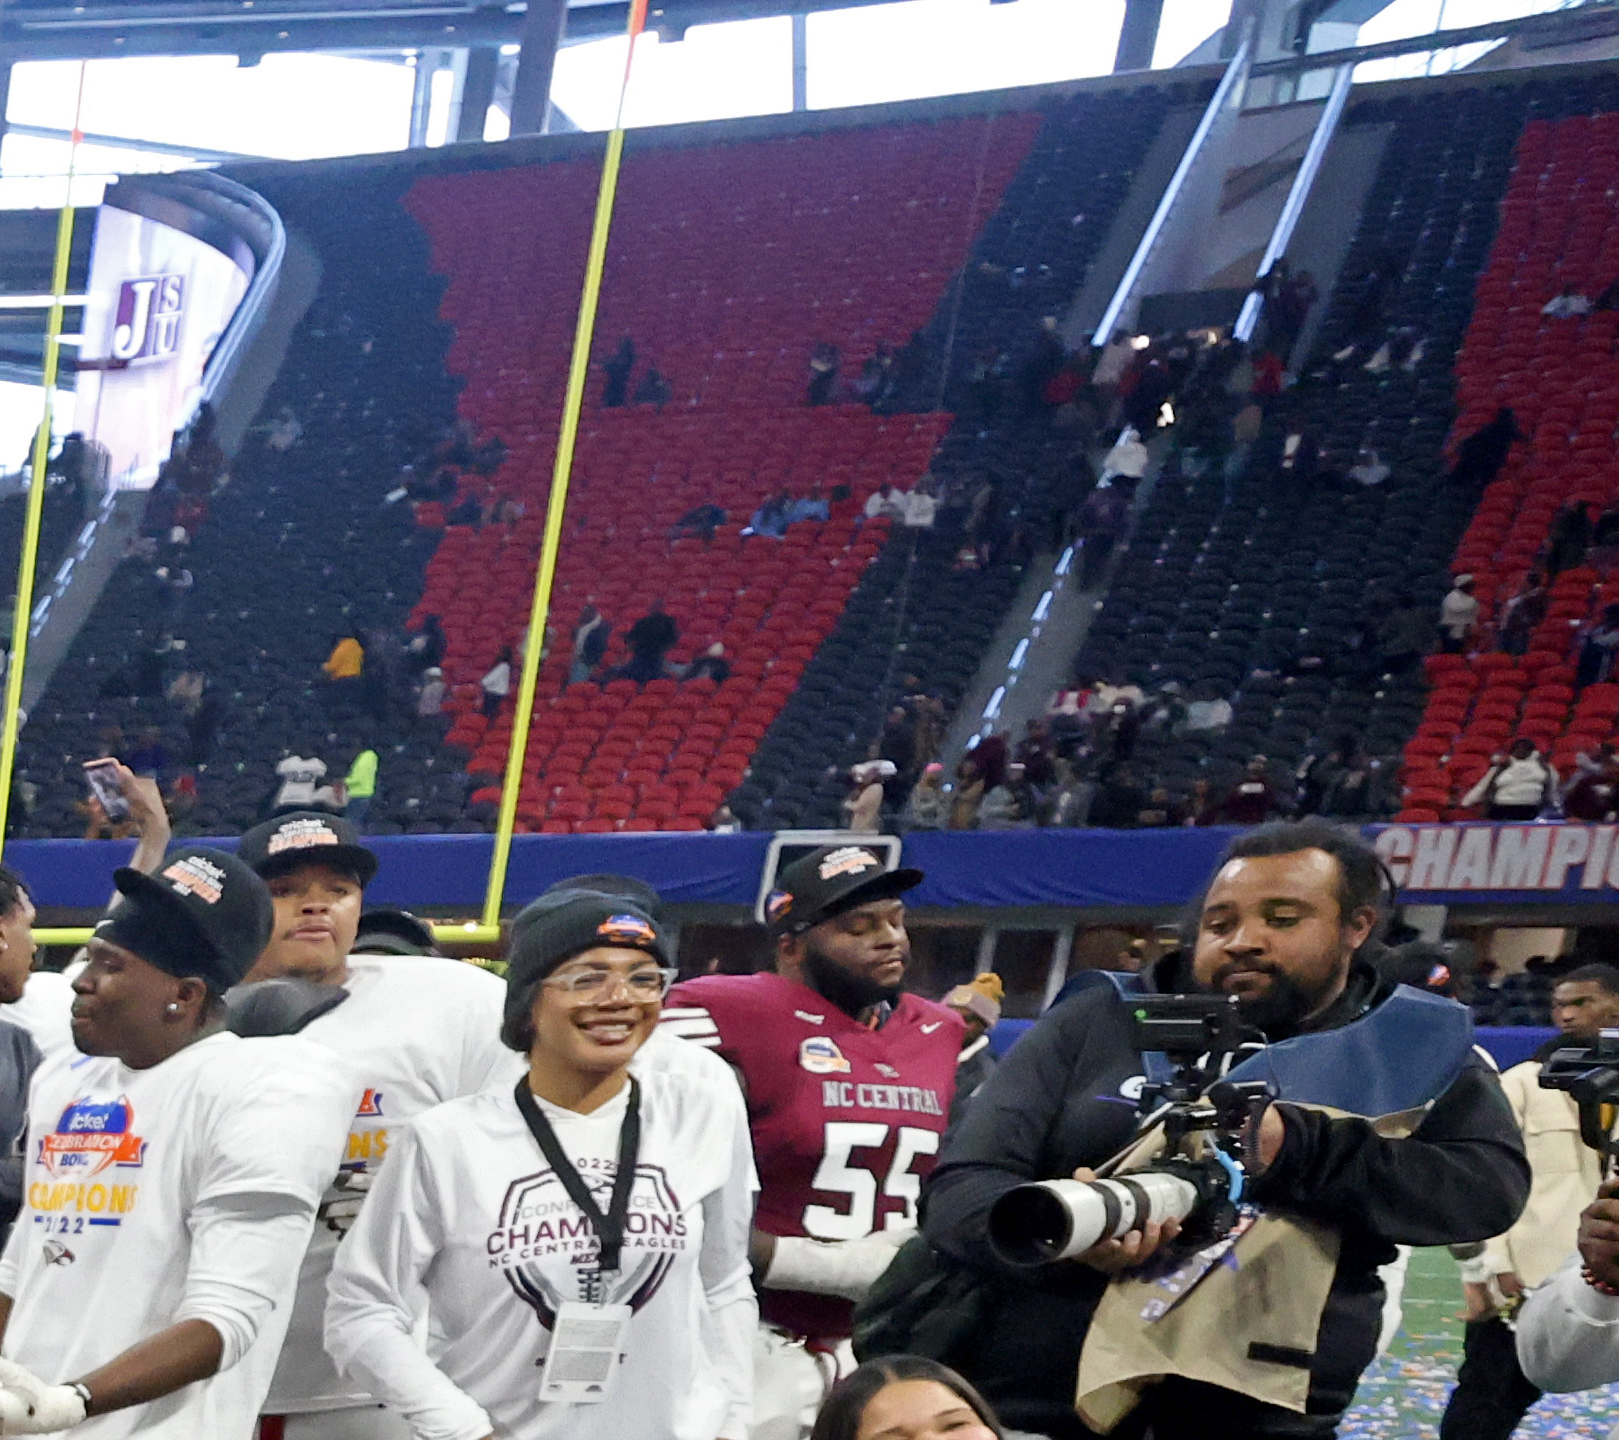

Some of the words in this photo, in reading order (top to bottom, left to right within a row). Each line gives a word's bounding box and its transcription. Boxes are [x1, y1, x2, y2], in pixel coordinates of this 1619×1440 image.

[823, 1082, 854, 1107] NC
[861, 1088, 943, 1116] CENTRAL
[488, 1250, 514, 1268] NC
